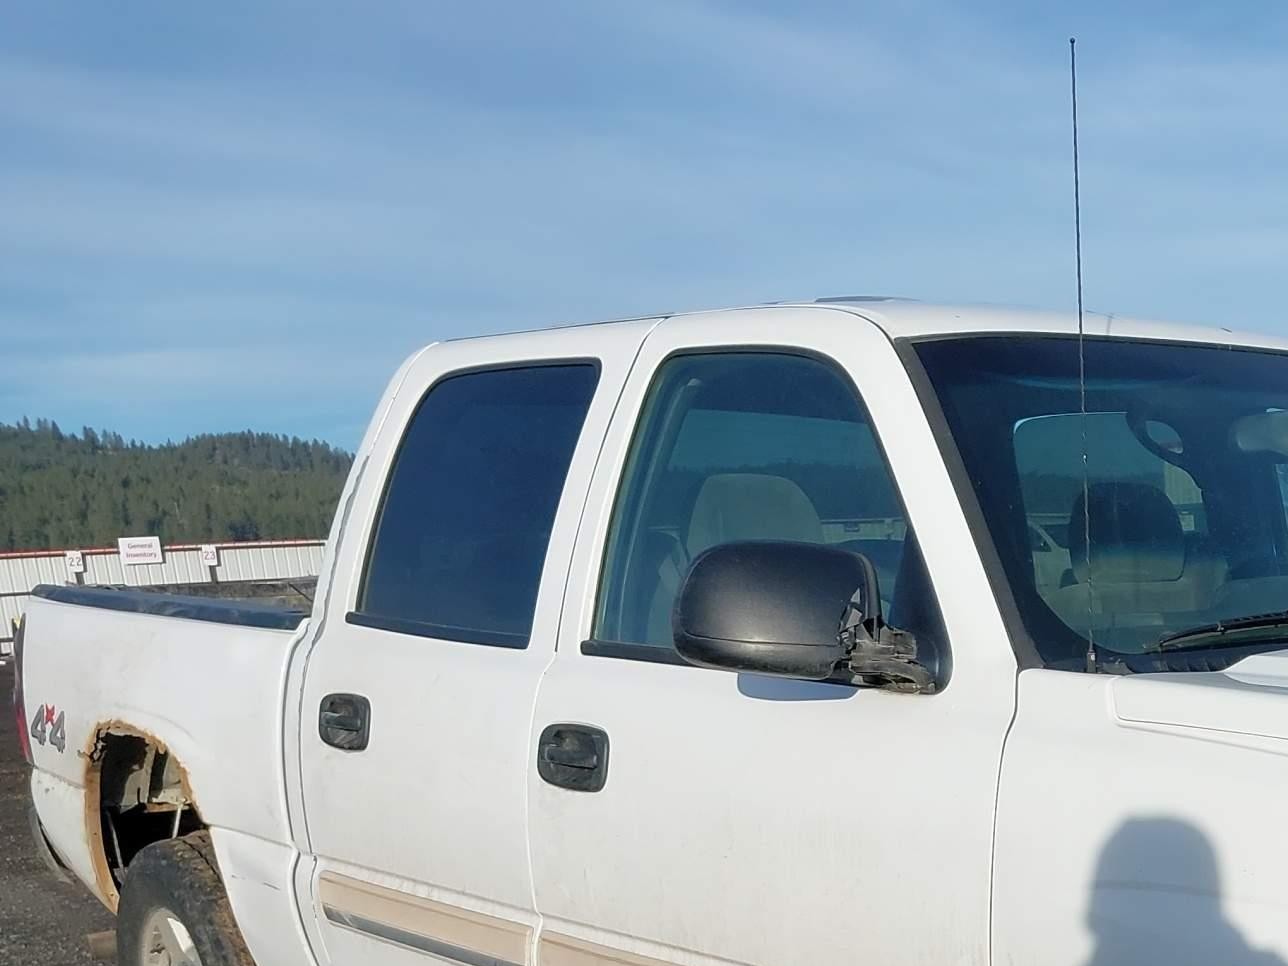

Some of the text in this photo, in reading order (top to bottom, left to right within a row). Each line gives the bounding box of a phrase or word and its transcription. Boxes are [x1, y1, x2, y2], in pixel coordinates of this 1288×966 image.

[126, 552, 157, 560] Inventory
[204, 550, 216, 561] 23
[69, 556, 81, 567] 22
